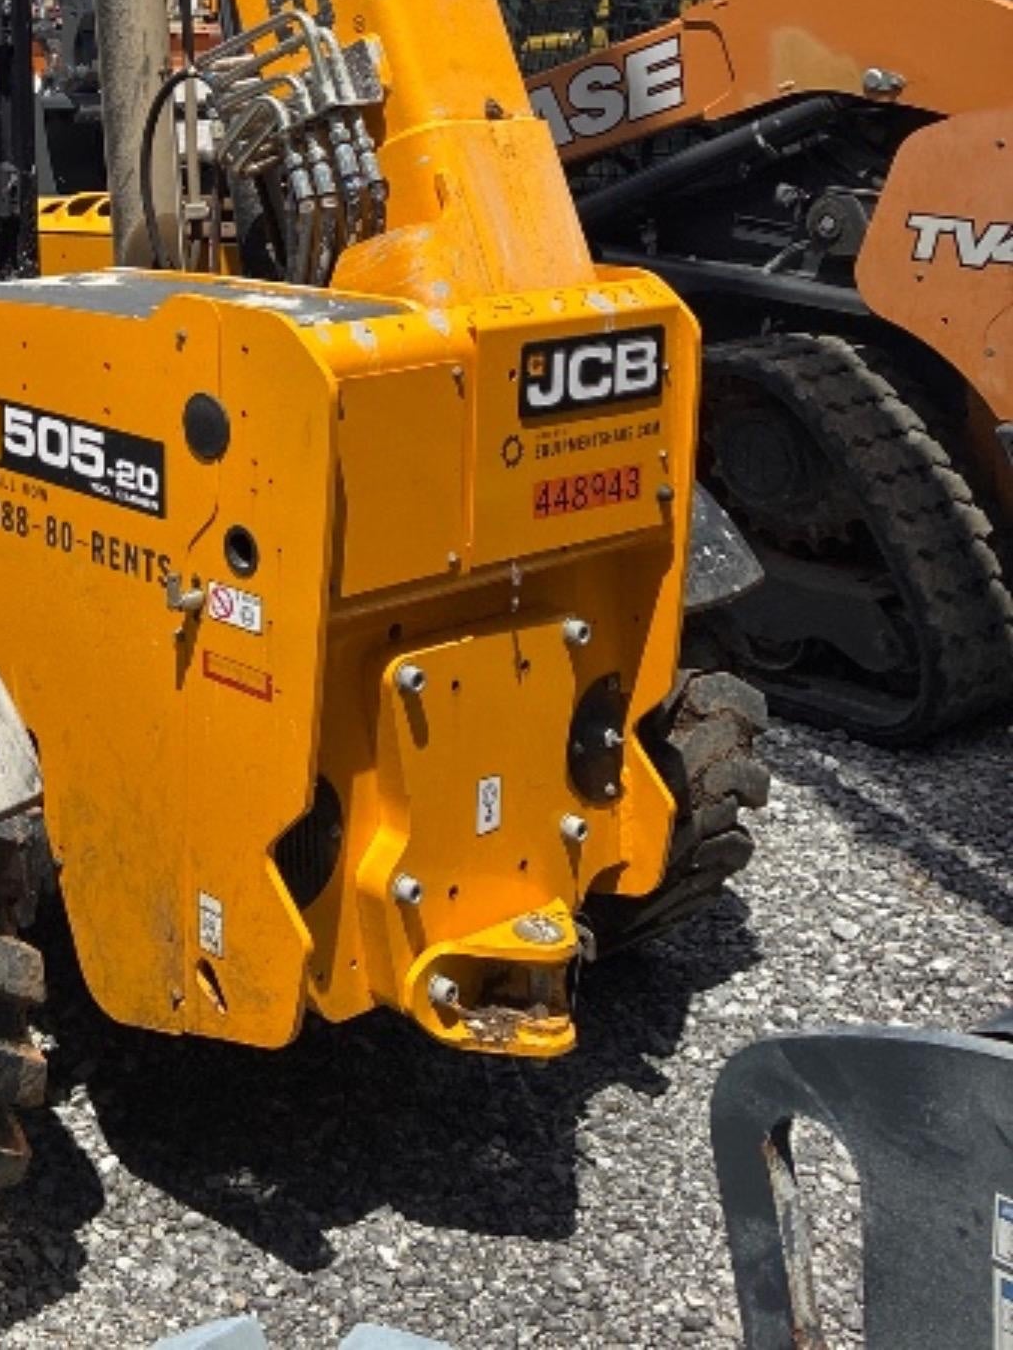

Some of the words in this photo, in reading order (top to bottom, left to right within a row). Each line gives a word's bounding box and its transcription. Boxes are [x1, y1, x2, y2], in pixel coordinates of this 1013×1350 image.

[529, 34, 685, 148] ASE
[525, 336, 659, 407] JCB
[534, 466, 640, 517] 448943
